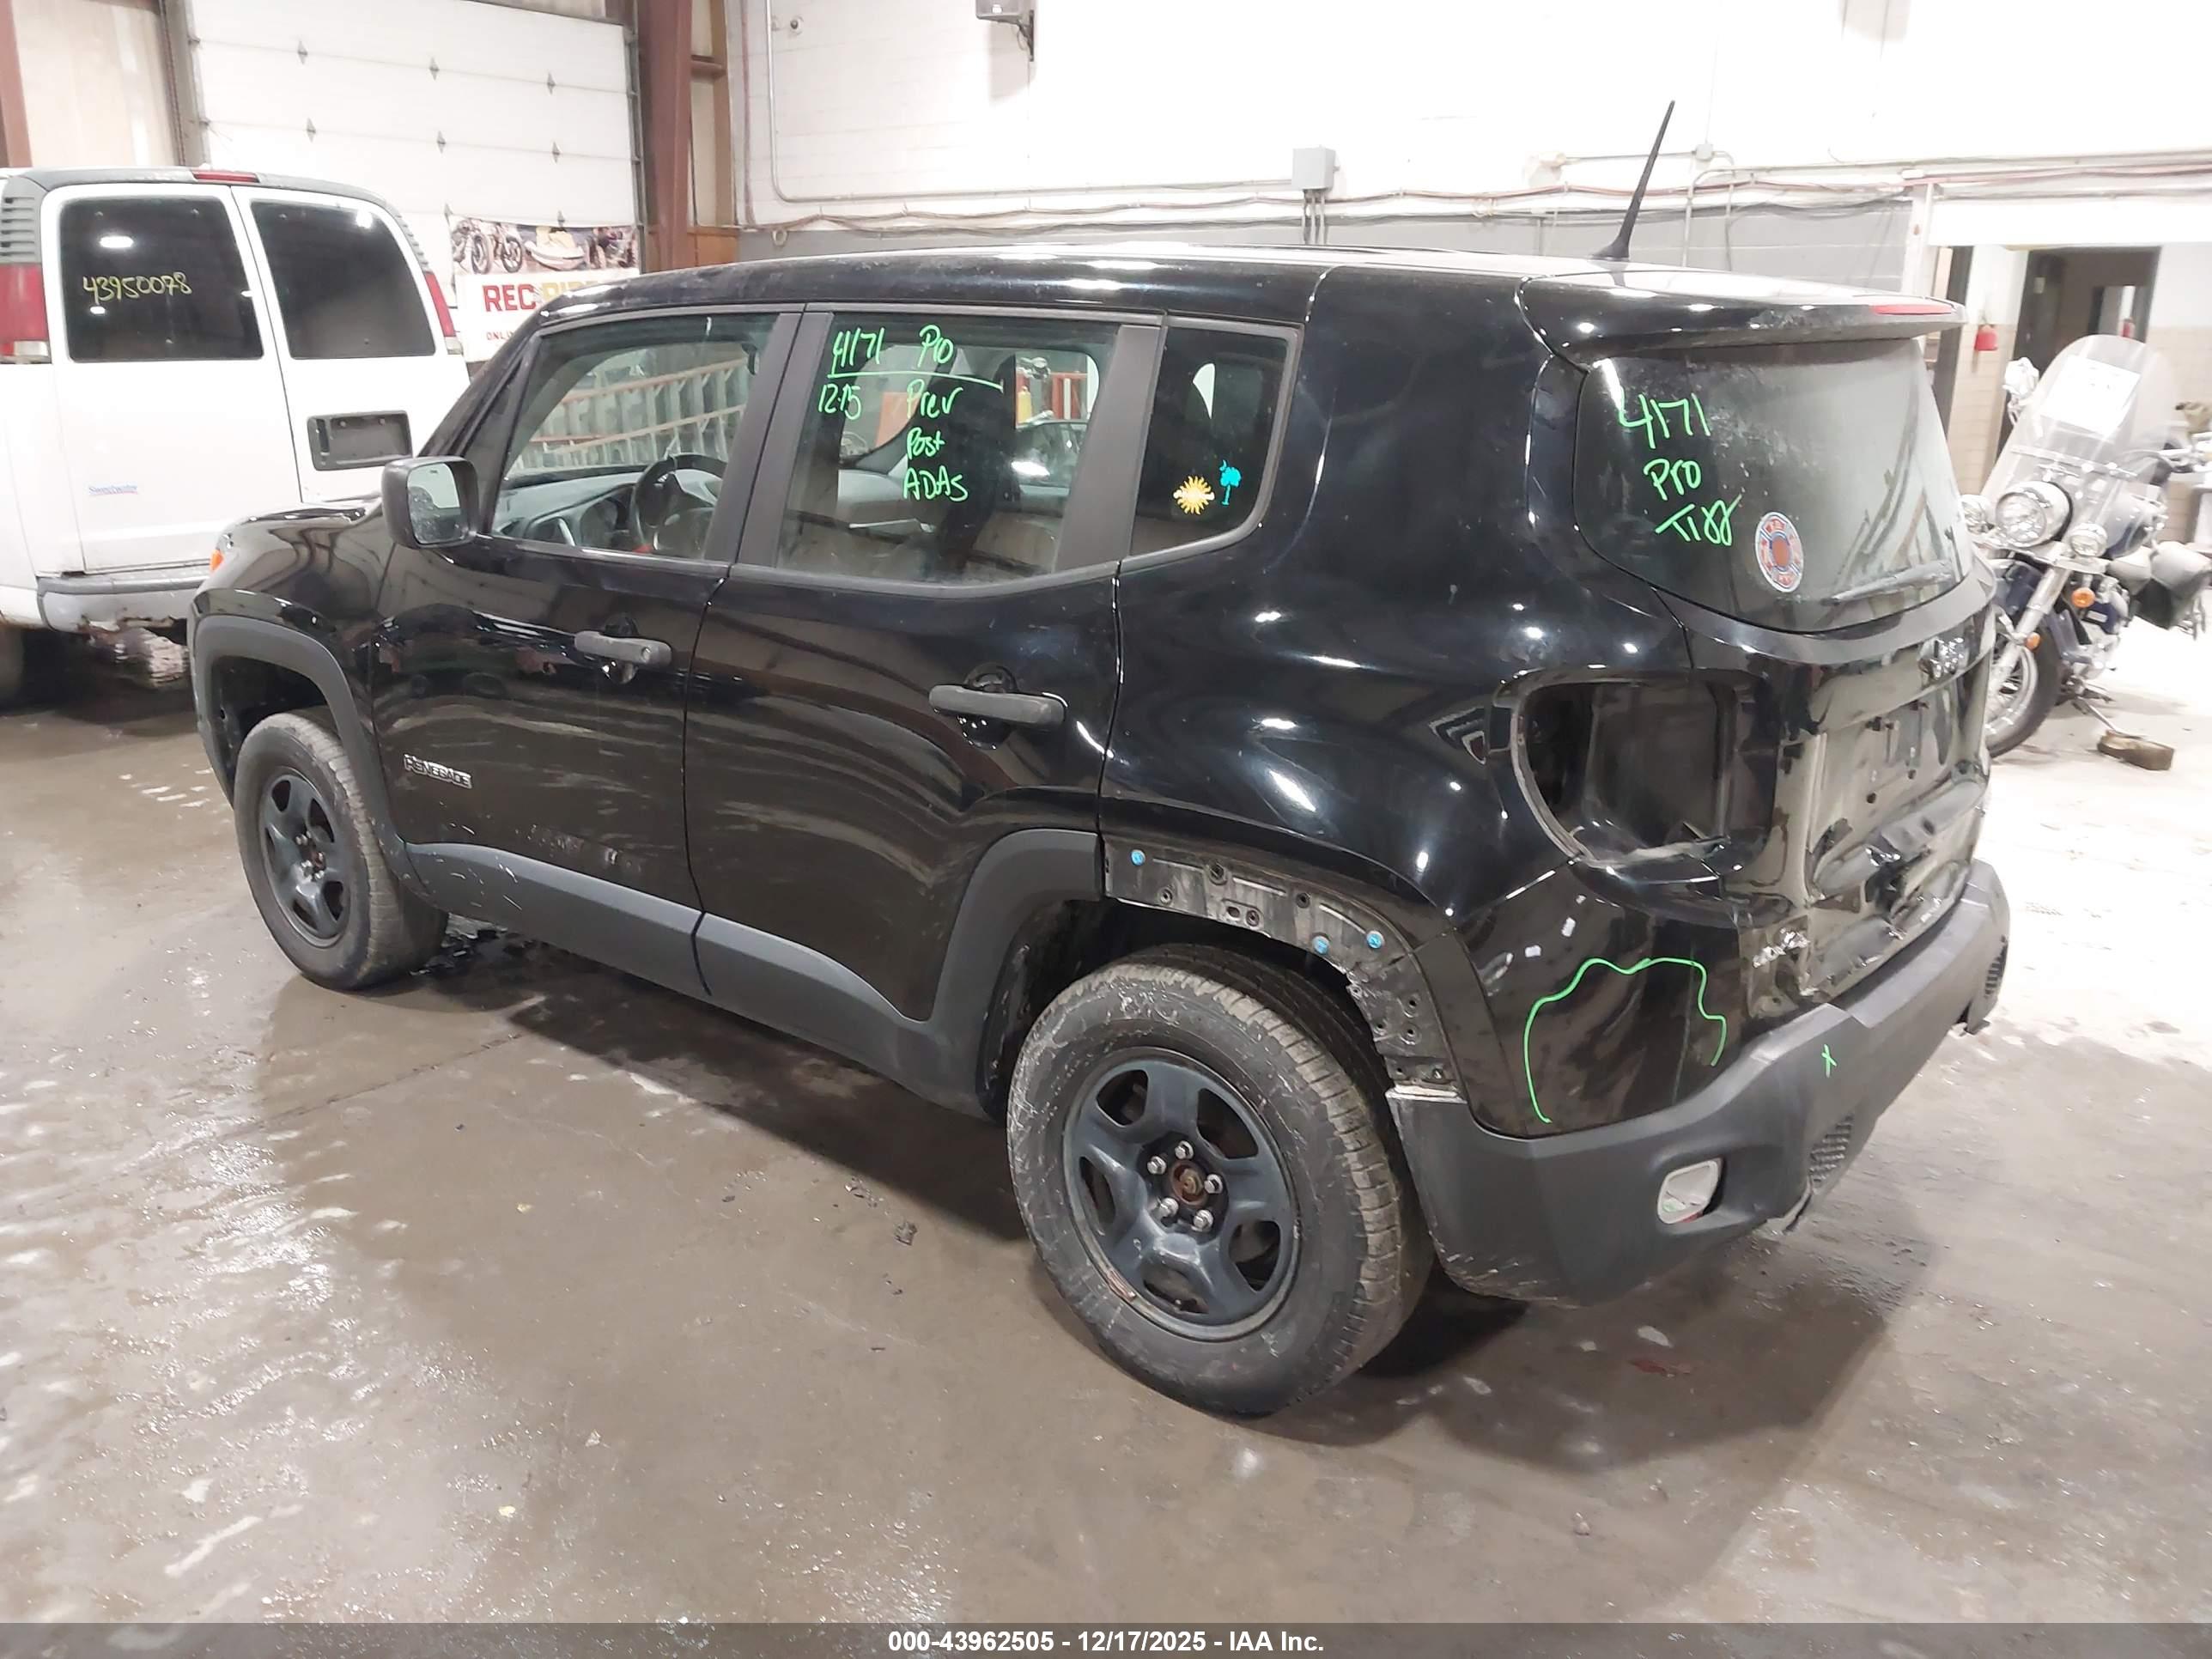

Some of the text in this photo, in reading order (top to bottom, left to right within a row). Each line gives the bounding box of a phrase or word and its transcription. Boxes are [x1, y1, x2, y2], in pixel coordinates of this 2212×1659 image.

[82, 271, 192, 305] 43950078
[483, 283, 537, 312] REC
[1618, 392, 1711, 449] 4171
